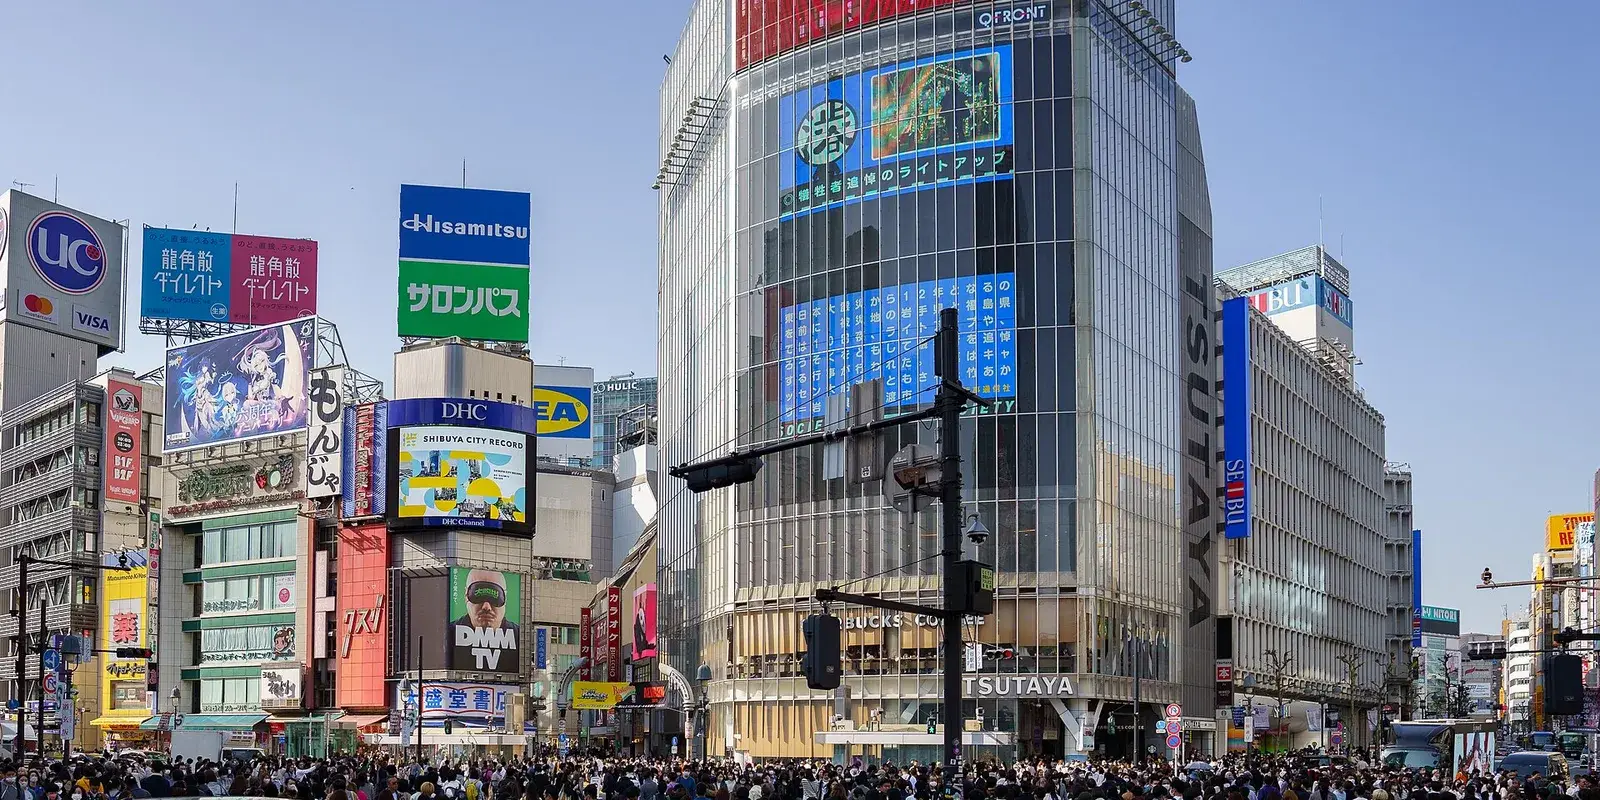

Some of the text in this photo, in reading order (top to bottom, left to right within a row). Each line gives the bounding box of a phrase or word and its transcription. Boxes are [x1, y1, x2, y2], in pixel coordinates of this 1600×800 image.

[979, 5, 1046, 28] QFRONT
[798, 151, 1006, 202] 犠牲者追悼のライトアップ
[402, 214, 528, 239] Hisamitsu
[38, 226, 99, 276] UC
[150, 233, 226, 246] のど、直接、うるおう
[237, 240, 313, 253] のど、直接、うるおう
[161, 248, 213, 272] 龍角散
[250, 254, 300, 279] 龍角散
[154, 271, 223, 296] ダイレクト
[242, 278, 310, 302] ダイレクト
[407, 282, 521, 318] サロンパス
[76, 311, 110, 331] VISA
[784, 297, 1011, 339] を前に被災地の岩手県と福島県
[785, 316, 1005, 355] では10日夜、ライトプや、
[785, 331, 1010, 370] ろうそくをともして犠を追悼
[607, 382, 638, 392] HULIC
[236, 404, 273, 423] 六周年
[441, 402, 487, 421] DHC
[534, 401, 580, 422] EA
[308, 369, 341, 493] もんじゃ
[423, 435, 464, 443] SHIBUYA
[466, 437, 487, 445] CITY
[489, 439, 524, 449] RECORD
[114, 455, 132, 468] B1F
[1186, 273, 1211, 628] TSUTAYA
[114, 469, 133, 481] B2F
[1226, 459, 1245, 525] SEIBU
[458, 518, 485, 527] Channel
[609, 593, 619, 642] カラオケ
[1433, 608, 1457, 620] NITORI
[113, 612, 138, 643] 薬
[341, 594, 384, 659] クスリ
[455, 624, 517, 650] DMM
[471, 648, 501, 670] TV
[1218, 668, 1230, 679] 本
[963, 677, 1073, 695] TSUTAYA
